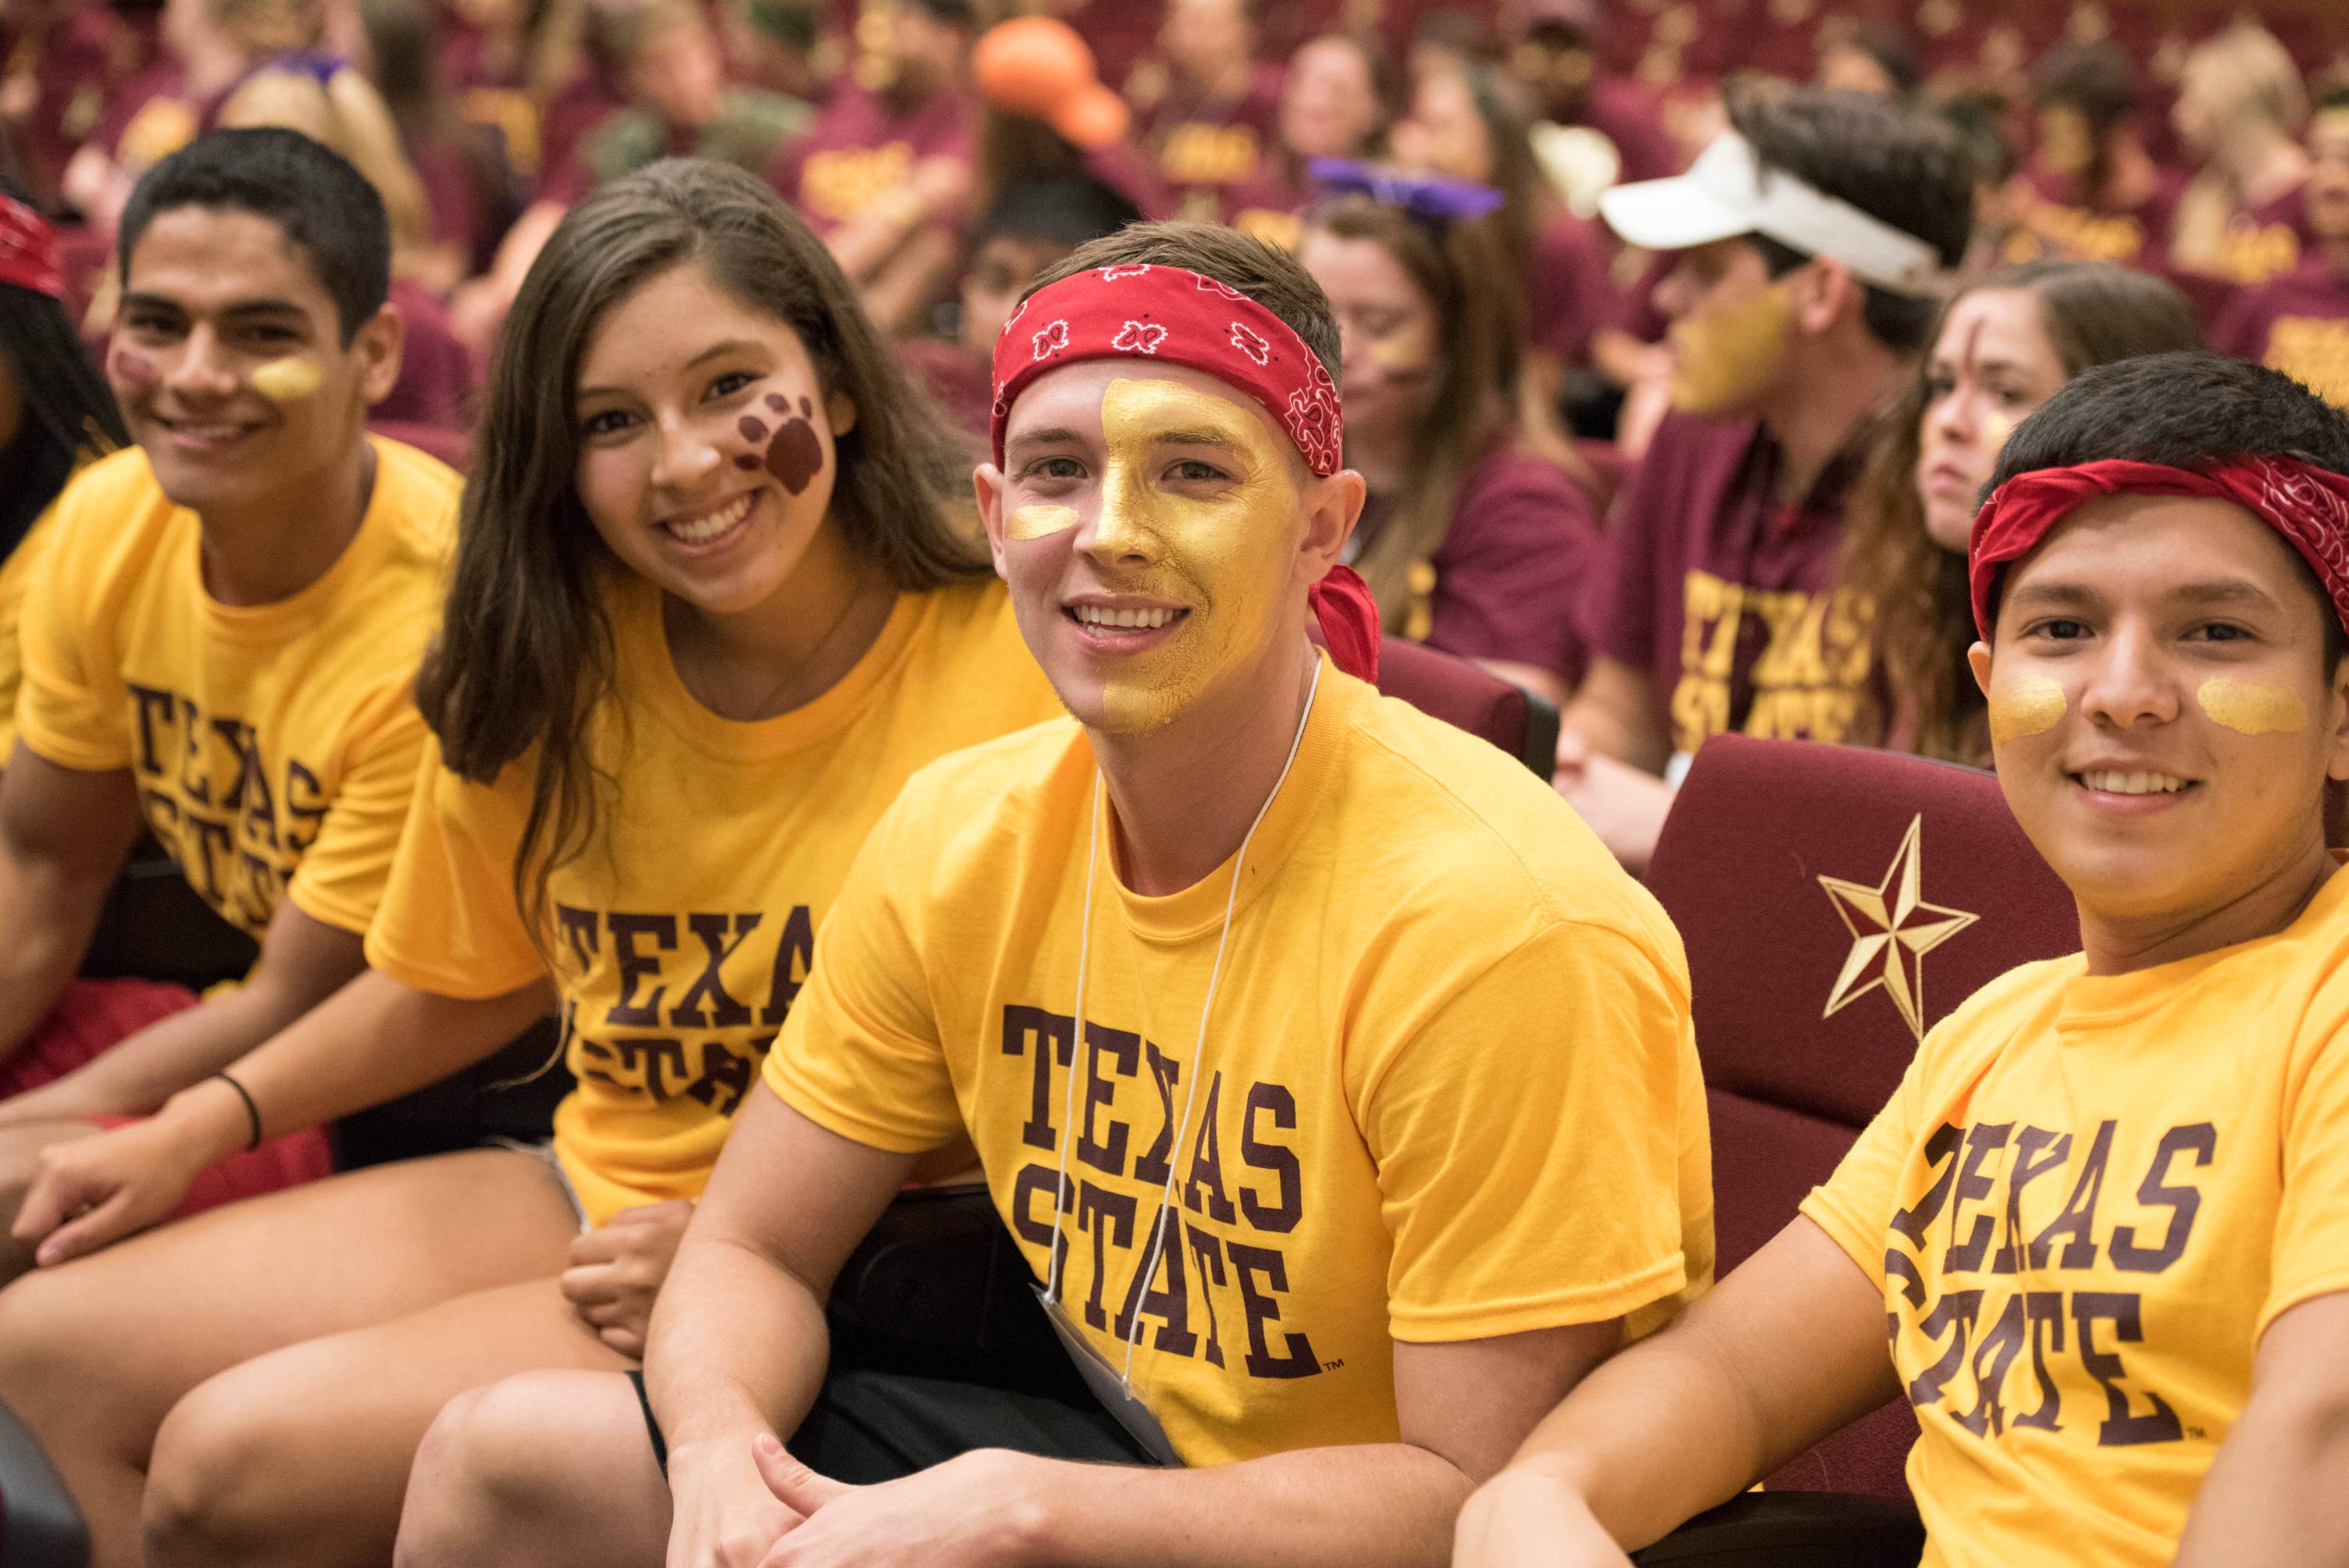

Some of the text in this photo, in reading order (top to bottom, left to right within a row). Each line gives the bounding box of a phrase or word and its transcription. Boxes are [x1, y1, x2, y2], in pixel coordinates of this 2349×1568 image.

[144, 786, 295, 926] STA
[556, 903, 814, 1028] TEXA
[582, 1037, 779, 1117] STA
[1002, 1004, 1303, 1234] TEXAS
[1012, 1163, 1322, 1379] STATE
[1889, 1119, 2217, 1275] TEXAS
[1884, 1247, 2183, 1446] STATE
